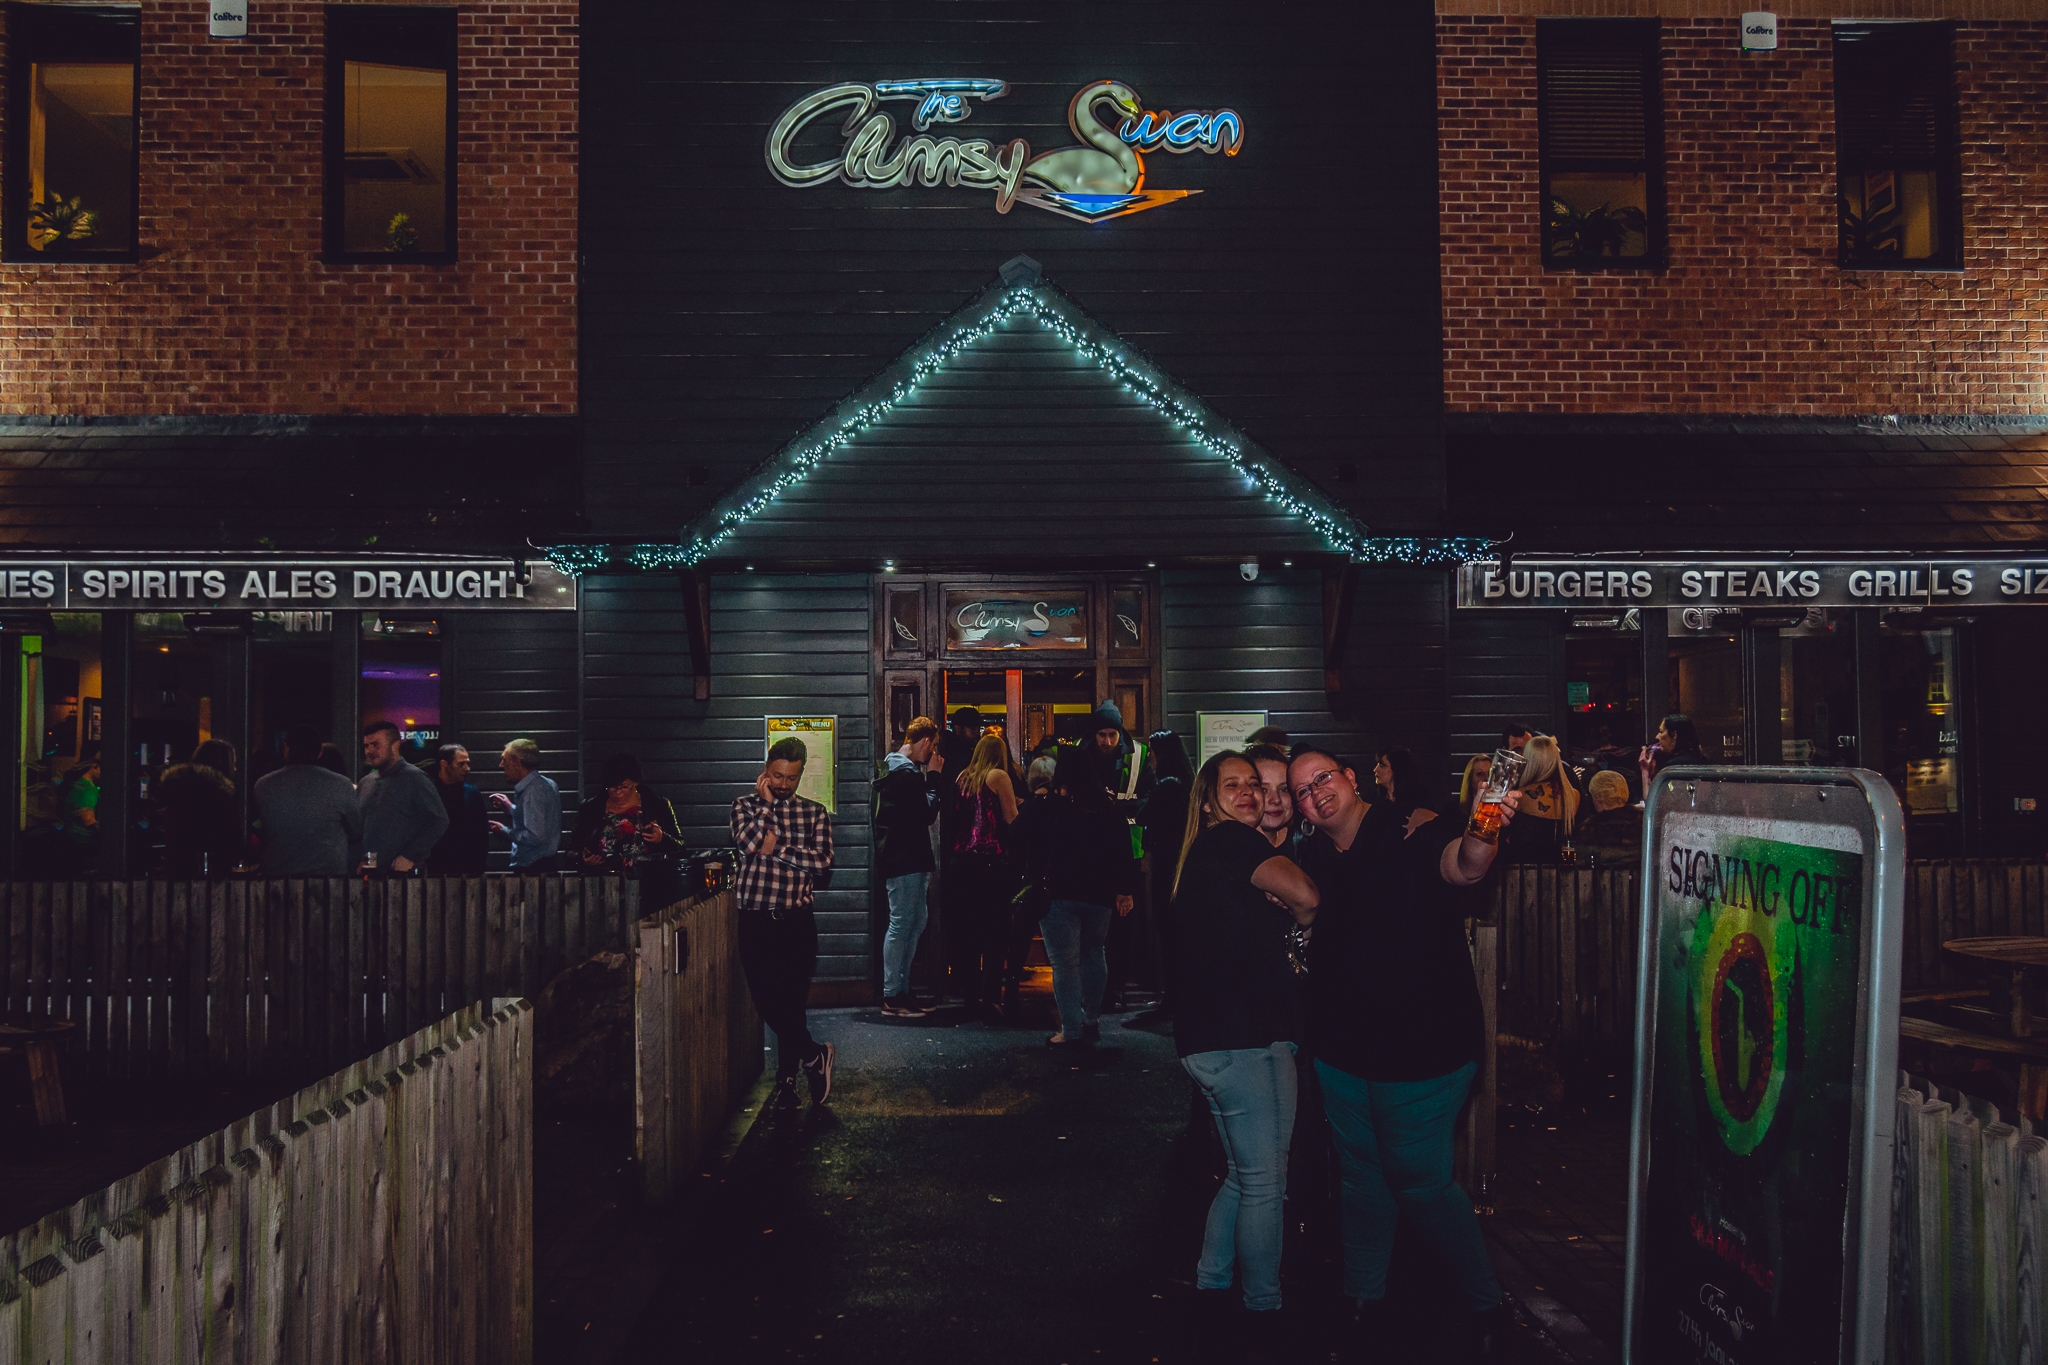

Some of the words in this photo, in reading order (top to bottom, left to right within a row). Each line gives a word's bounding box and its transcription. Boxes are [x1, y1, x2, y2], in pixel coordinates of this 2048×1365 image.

[213, 12, 243, 21] Calibre
[1746, 26, 1774, 35] Calibre
[875, 79, 1008, 130] The
[766, 82, 1030, 214] Clumsy
[1025, 80, 1243, 195] Swan
[82, 570, 226, 598] SPIRITS
[240, 570, 337, 598] ALES
[1484, 571, 1653, 598] BURGERS
[1681, 570, 1820, 597] STEAKS
[1848, 569, 1973, 597] GRILLS
[957, 602, 1020, 632] Clumsy
[1669, 845, 1780, 917] SIGNING
[1789, 868, 1851, 935] OFF
[1679, 1309, 1702, 1347] 27th
